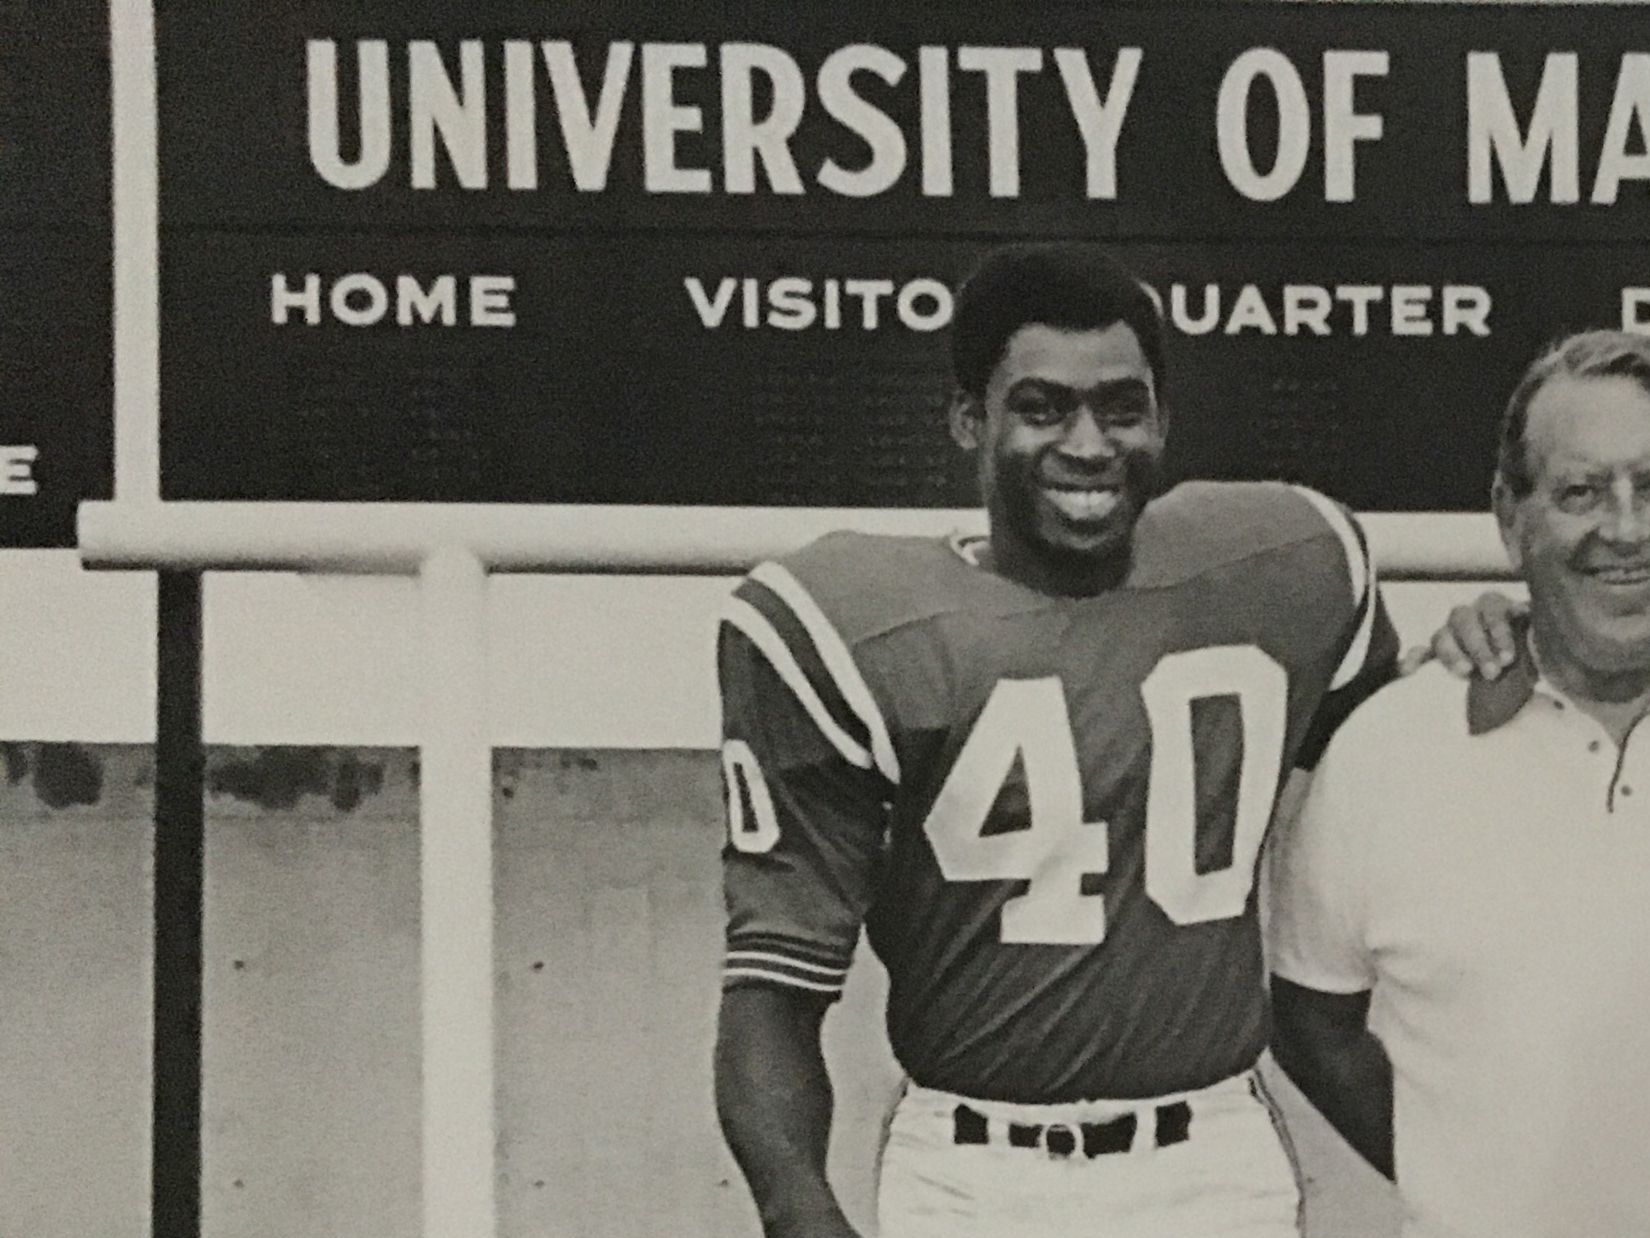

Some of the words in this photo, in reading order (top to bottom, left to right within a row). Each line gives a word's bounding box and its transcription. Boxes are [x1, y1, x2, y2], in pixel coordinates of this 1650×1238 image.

[306, 38, 1143, 200] UNIVERSITY
[1215, 46, 1390, 203] OF
[270, 273, 517, 327] HOME
[683, 276, 956, 331] VISITO
[1136, 281, 1493, 337] UARTER
[923, 644, 1288, 945] 40
